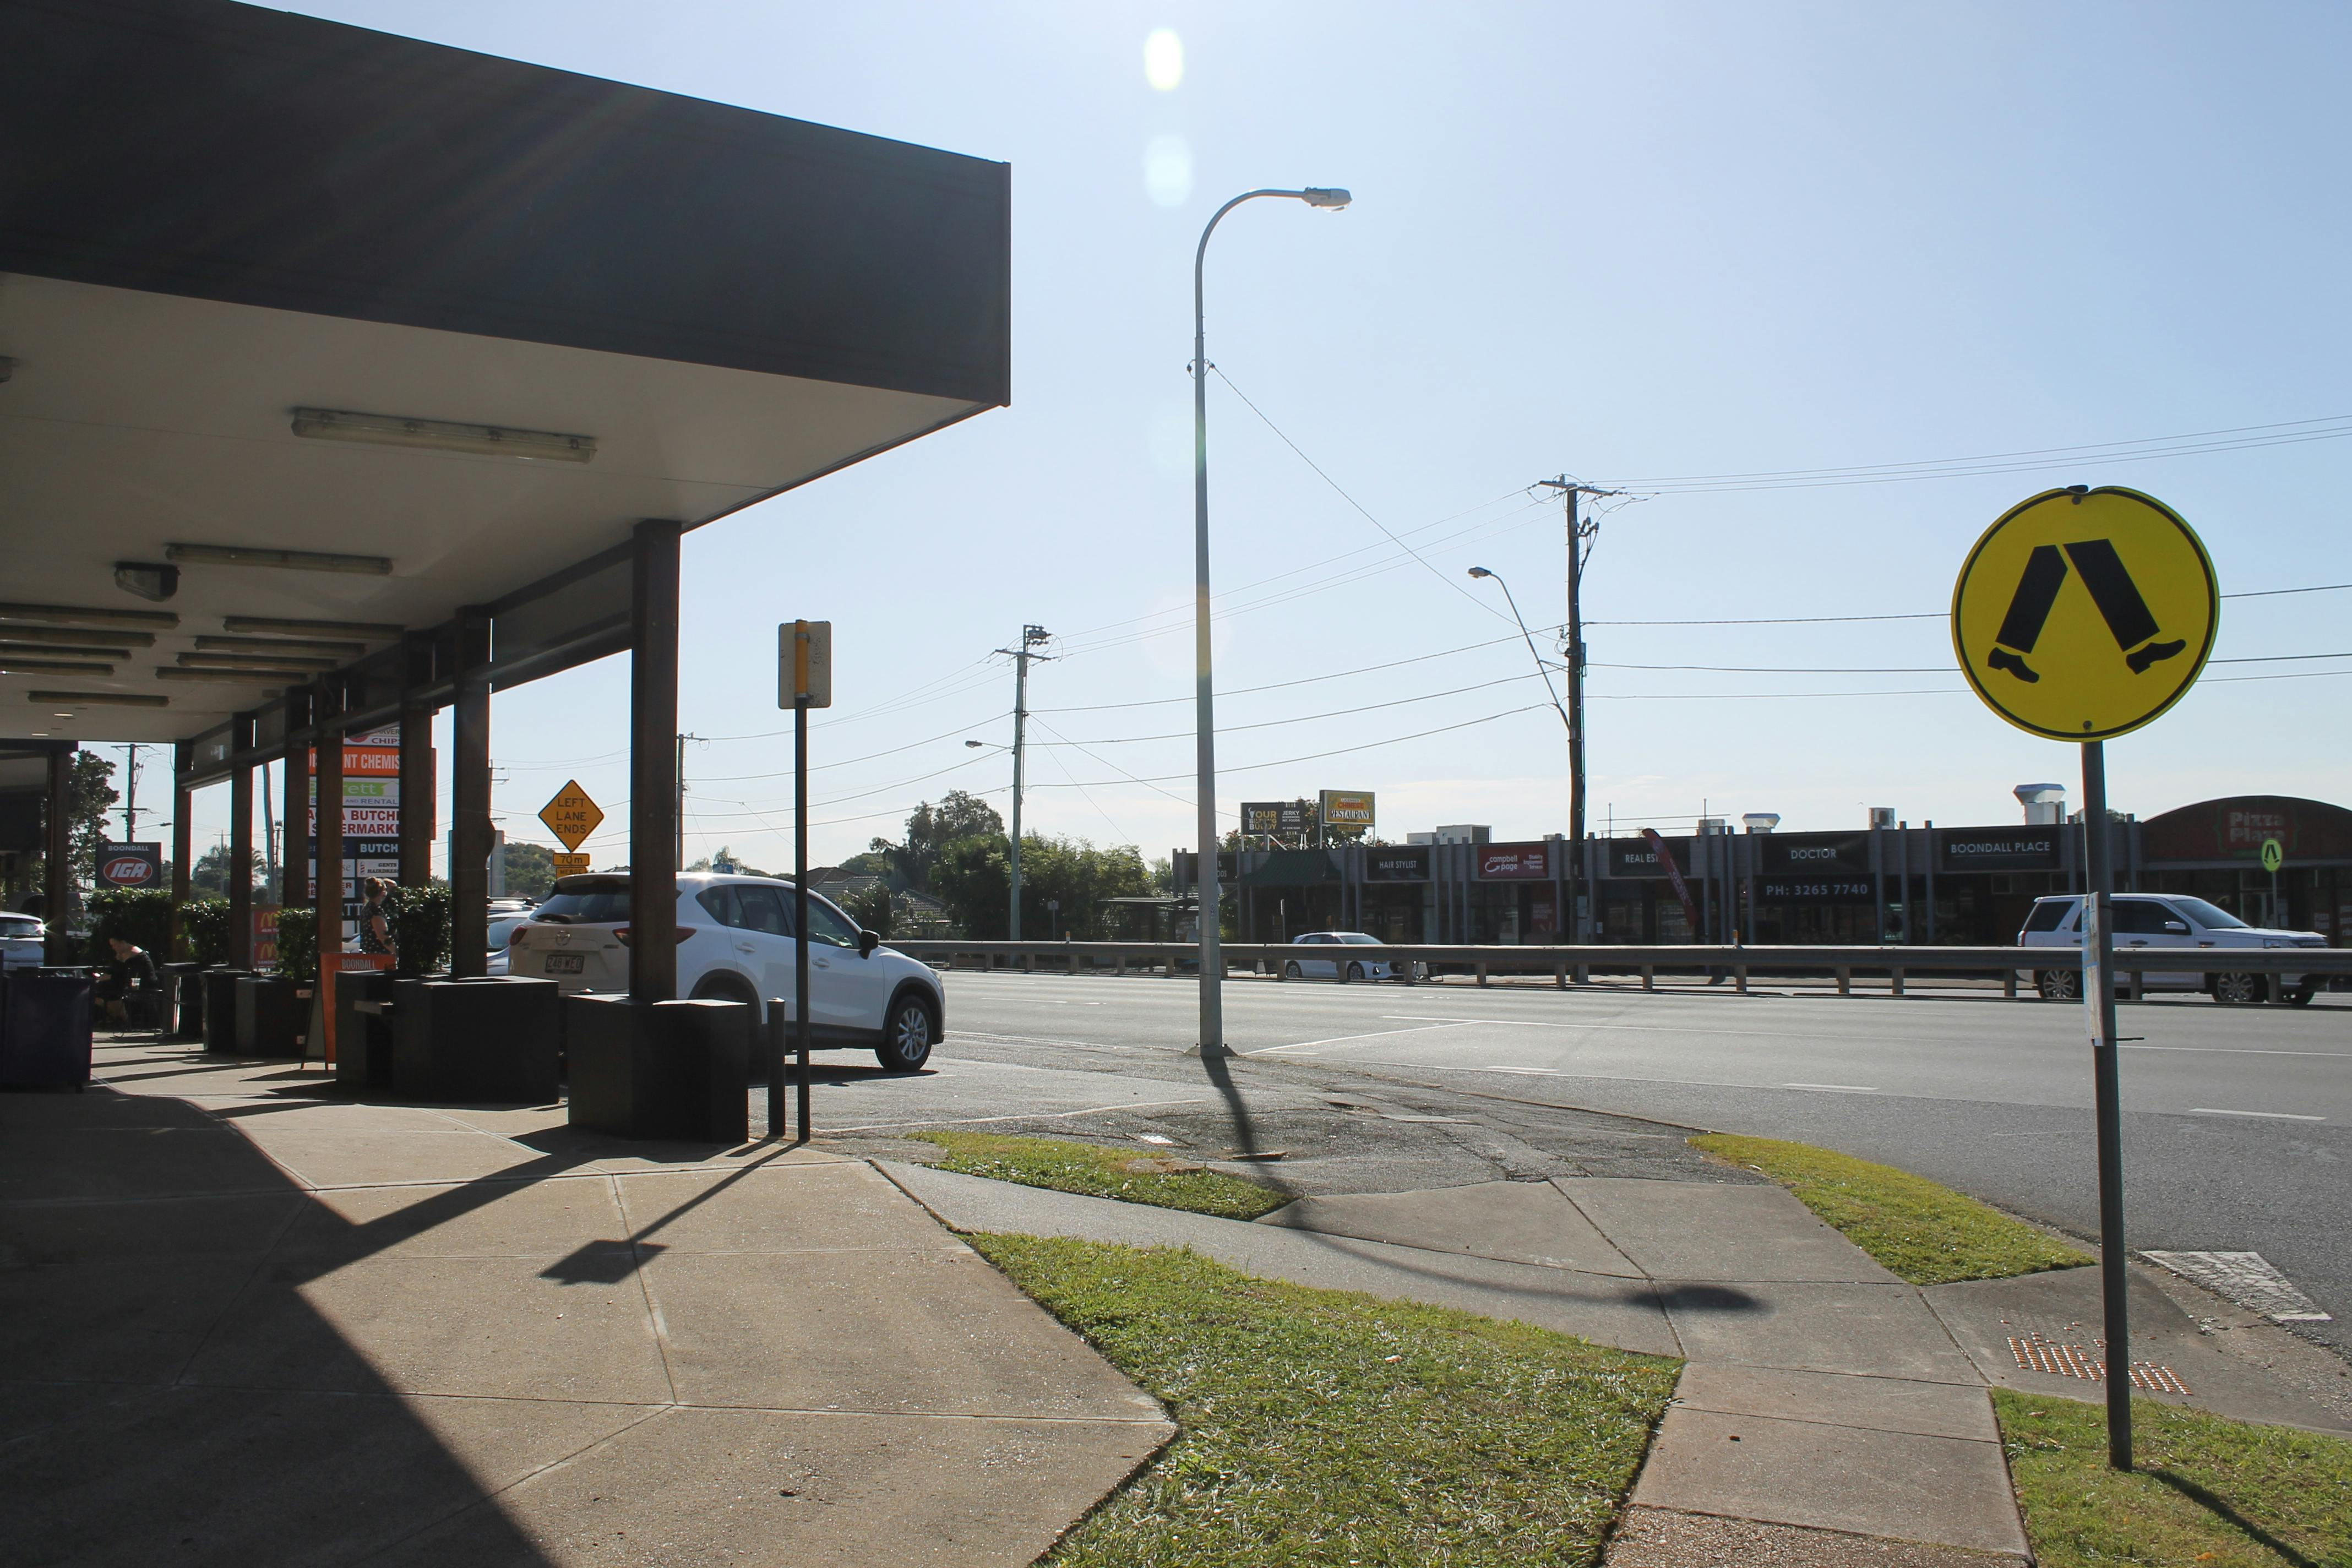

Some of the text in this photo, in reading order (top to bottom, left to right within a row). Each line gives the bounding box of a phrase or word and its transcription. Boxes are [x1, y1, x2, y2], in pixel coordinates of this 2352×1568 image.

[361, 754, 400, 769] CHEMIS
[558, 798, 585, 807] LEFT
[556, 812, 586, 821] LANE
[1330, 810, 1370, 819] RESTAURANT
[2229, 812, 2284, 826] Pizza
[557, 824, 586, 834] ENDS
[1951, 842, 2050, 853] BOONDALL PLACE
[1489, 854, 1518, 863] campbell
[1625, 854, 1660, 863] REAL EST
[1790, 848, 1837, 859] DOCTOR
[1379, 860, 1417, 869] HAIR STYLIST
[110, 863, 148, 878] IGA
[1766, 884, 1868, 895] PH: 3265 7740
[342, 959, 375, 970] BOONDALL
